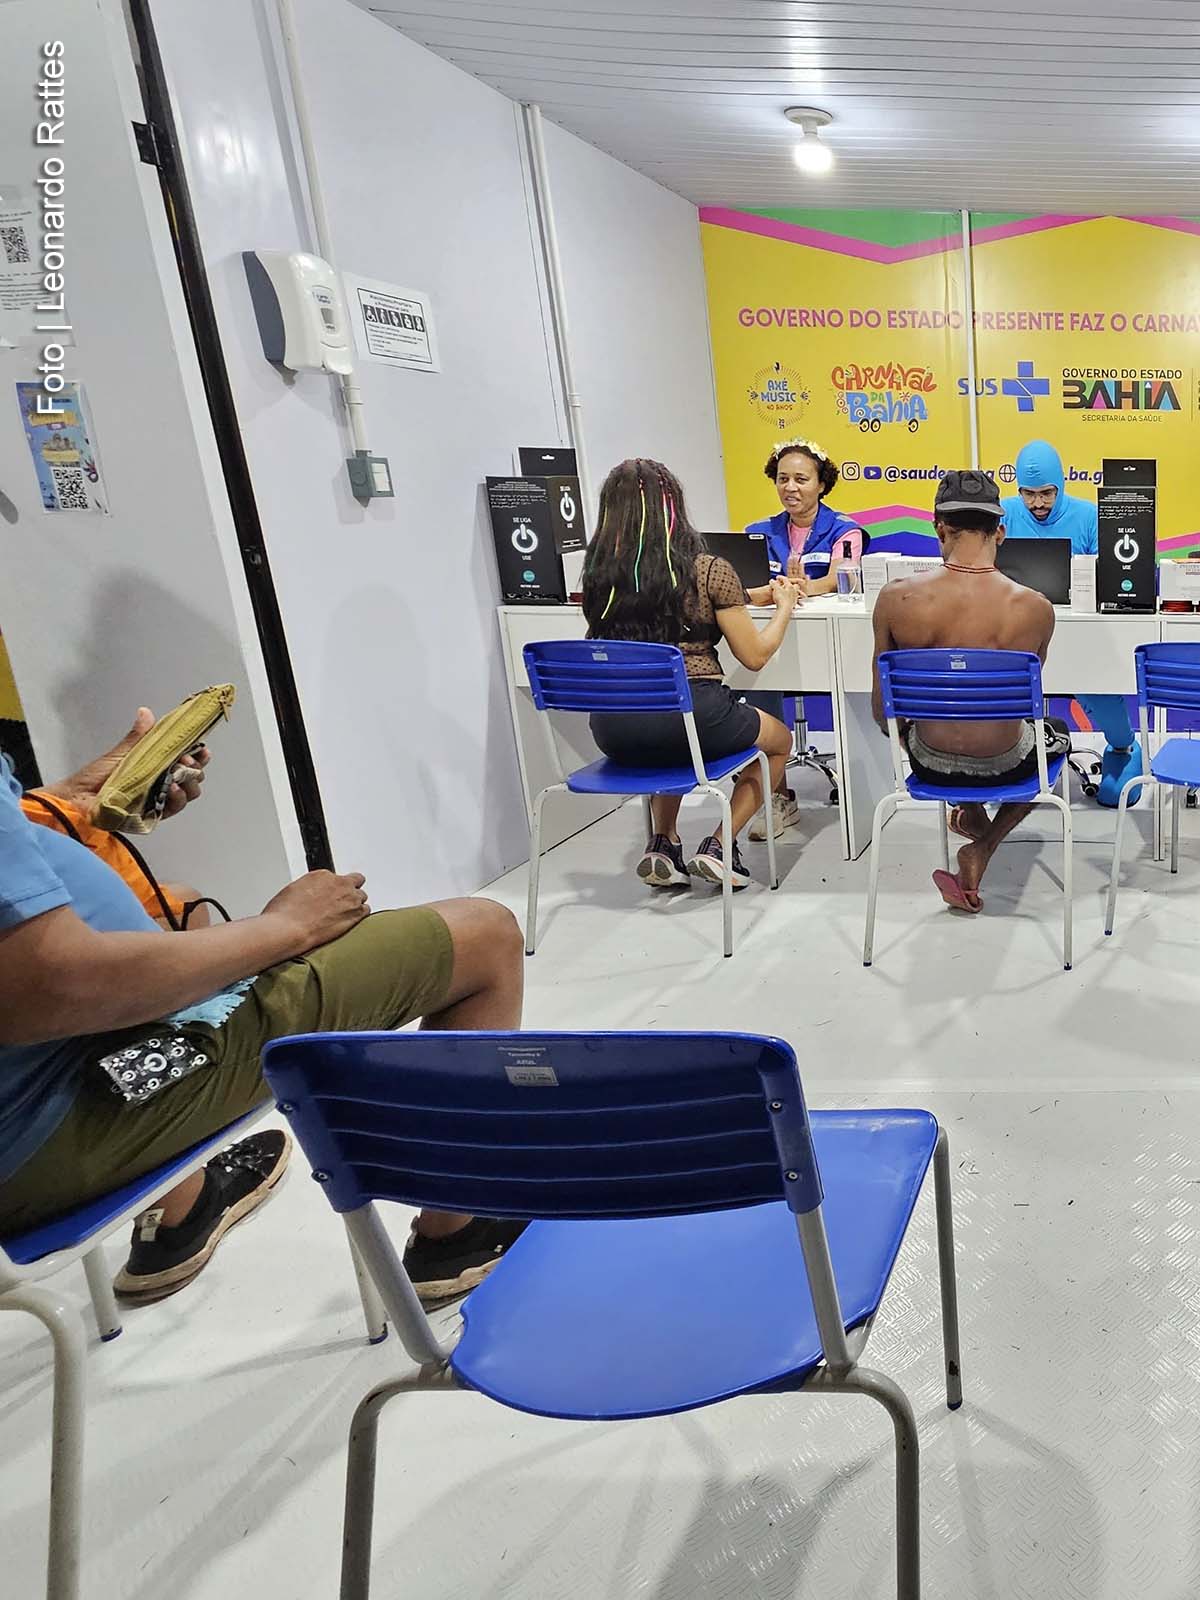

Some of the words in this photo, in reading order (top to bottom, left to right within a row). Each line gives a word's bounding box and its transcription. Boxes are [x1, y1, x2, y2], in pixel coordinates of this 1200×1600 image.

[738, 308, 844, 328] GOVERNO
[849, 309, 882, 328] DO
[887, 310, 964, 329] ESTADO
[972, 311, 1064, 331] PRESENTE
[1070, 312, 1105, 331] FAZ
[1110, 312, 1127, 332] O
[1062, 368, 1118, 379] GOVERNO
[1121, 369, 1137, 379] DO
[1140, 369, 1183, 380] ESTADO
[957, 377, 998, 396] SUS
[760, 392, 797, 403] MUSIC
[1081, 414, 1125, 422] SECRETARIA
[1139, 414, 1162, 423] SAÚDE
